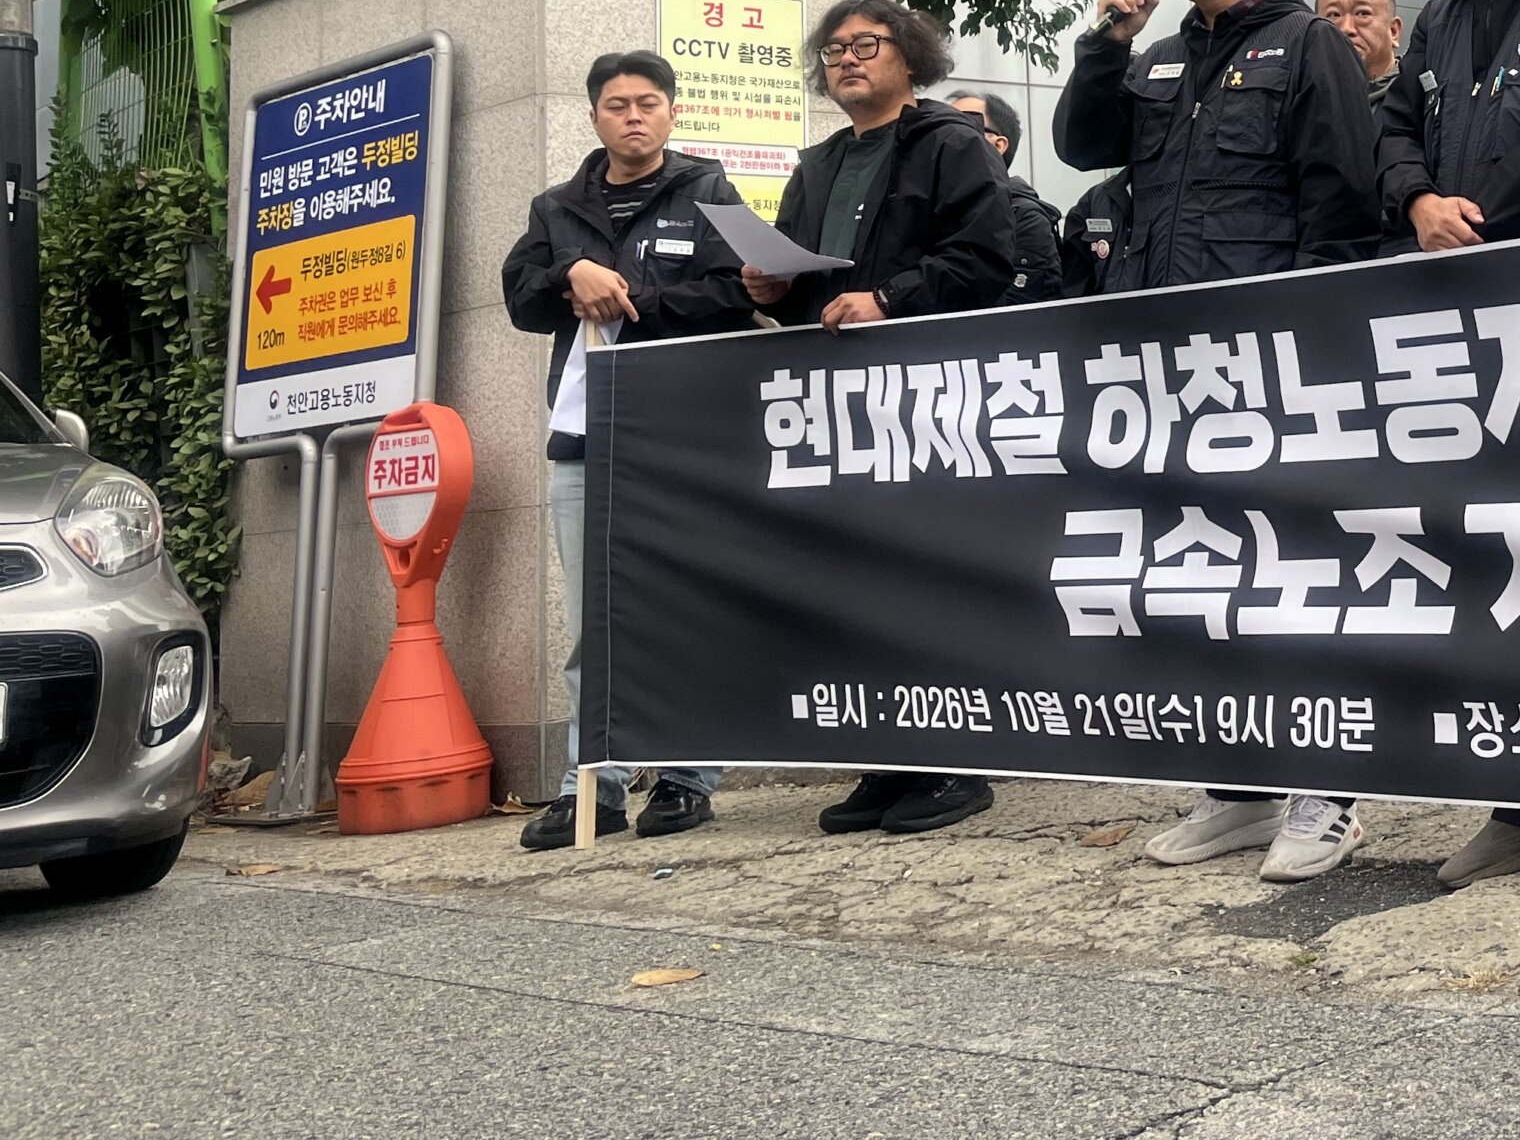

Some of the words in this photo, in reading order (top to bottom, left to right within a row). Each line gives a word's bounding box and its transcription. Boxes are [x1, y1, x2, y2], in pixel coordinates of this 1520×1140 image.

[673, 37, 730, 60] CCTV
[738, 43, 793, 67] 촬영중
[688, 88, 706, 99] 불법
[710, 89, 728, 101] 행위
[749, 76, 801, 90] 국가재산으로
[314, 79, 386, 130] 주차안내
[723, 107, 741, 118] 의거
[259, 165, 285, 199] 민원
[288, 158, 313, 191] 방문
[316, 147, 358, 181] 고객은
[361, 130, 419, 171] 두정빌딩
[256, 197, 306, 235] 주차장을
[309, 177, 395, 221] 이용해주세요.
[298, 291, 336, 317] 주차권은
[339, 286, 359, 309] 업무
[362, 281, 383, 303] 보신
[385, 278, 397, 299] 후
[257, 328, 285, 350] 120m
[297, 317, 336, 343] 직원에게
[338, 306, 401, 336] 문의해주세요.
[287, 380, 376, 415] 천안고용노동지청
[759, 351, 1069, 489] 현대제철
[373, 453, 435, 490] 주차금지
[1049, 506, 1456, 640] 금속노조
[812, 683, 868, 729] 일시
[893, 685, 993, 733] 2026년
[1000, 690, 1071, 736] 10월
[1074, 692, 1207, 744] 21일(수)
[1216, 694, 1275, 748] 9시
[1289, 696, 1376, 752] 30분
